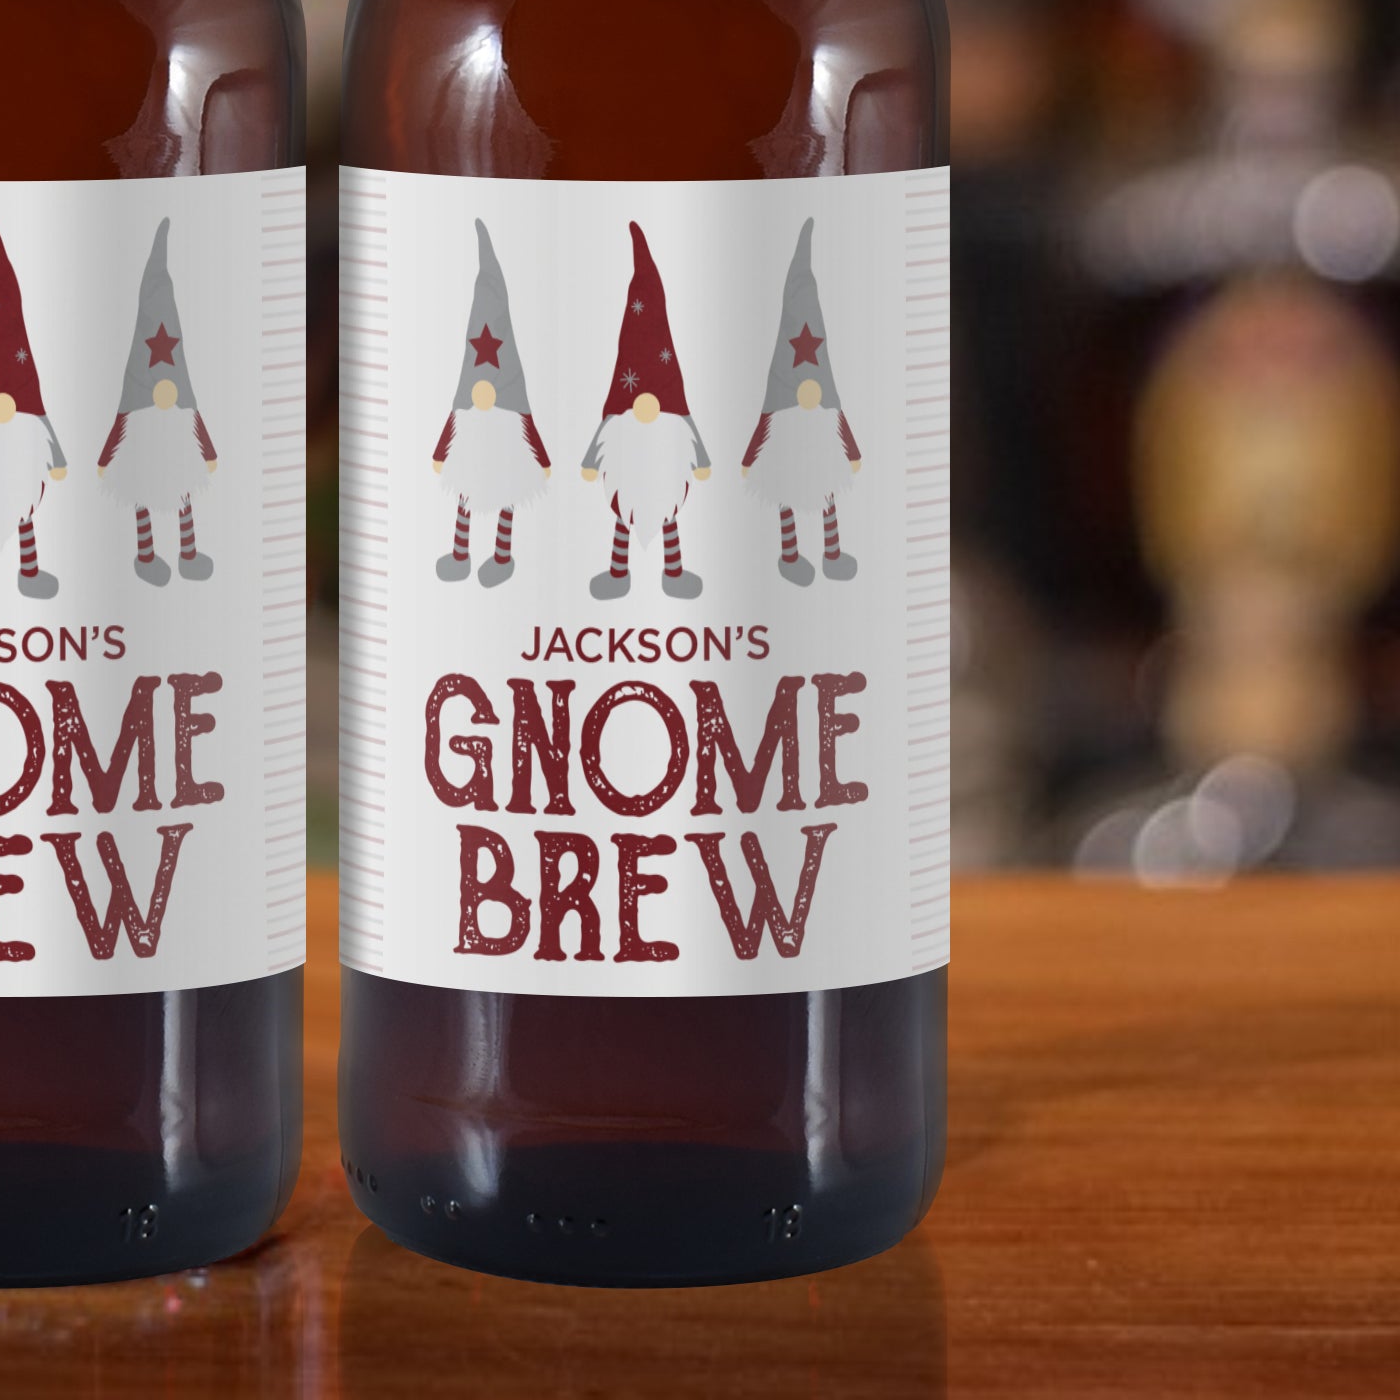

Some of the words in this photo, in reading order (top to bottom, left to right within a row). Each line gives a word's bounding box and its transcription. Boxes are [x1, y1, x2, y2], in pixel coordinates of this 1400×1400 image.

[521, 625, 769, 663] JACKSON'S
[424, 672, 868, 818] GNOME
[452, 823, 837, 964] BREW
